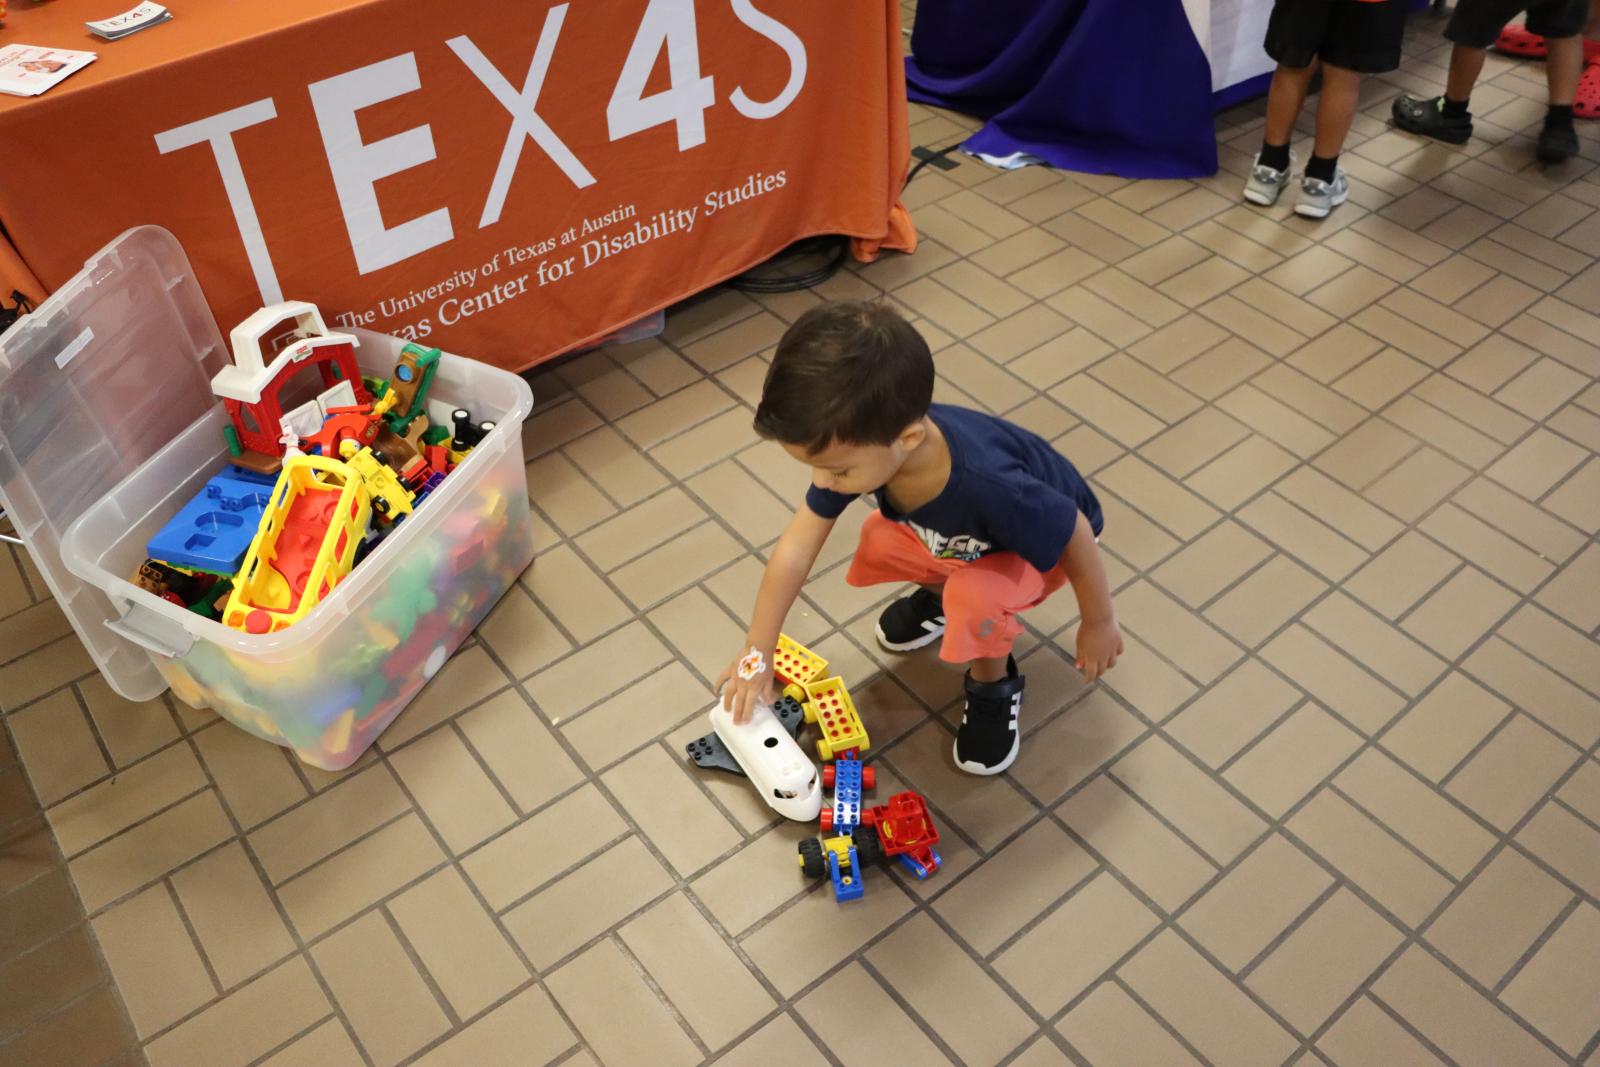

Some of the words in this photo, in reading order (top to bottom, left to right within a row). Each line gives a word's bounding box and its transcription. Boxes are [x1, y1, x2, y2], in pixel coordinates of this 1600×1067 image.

[153, 0, 808, 306] TEX4S
[335, 310, 376, 328] The
[378, 267, 477, 318] University
[481, 254, 499, 276] of
[503, 237, 556, 266] Texas
[560, 228, 577, 245] at
[581, 203, 636, 237] Austin
[438, 274, 528, 325] Center
[536, 256, 575, 287] for
[581, 206, 698, 269] Disability
[703, 170, 787, 217] Studies
